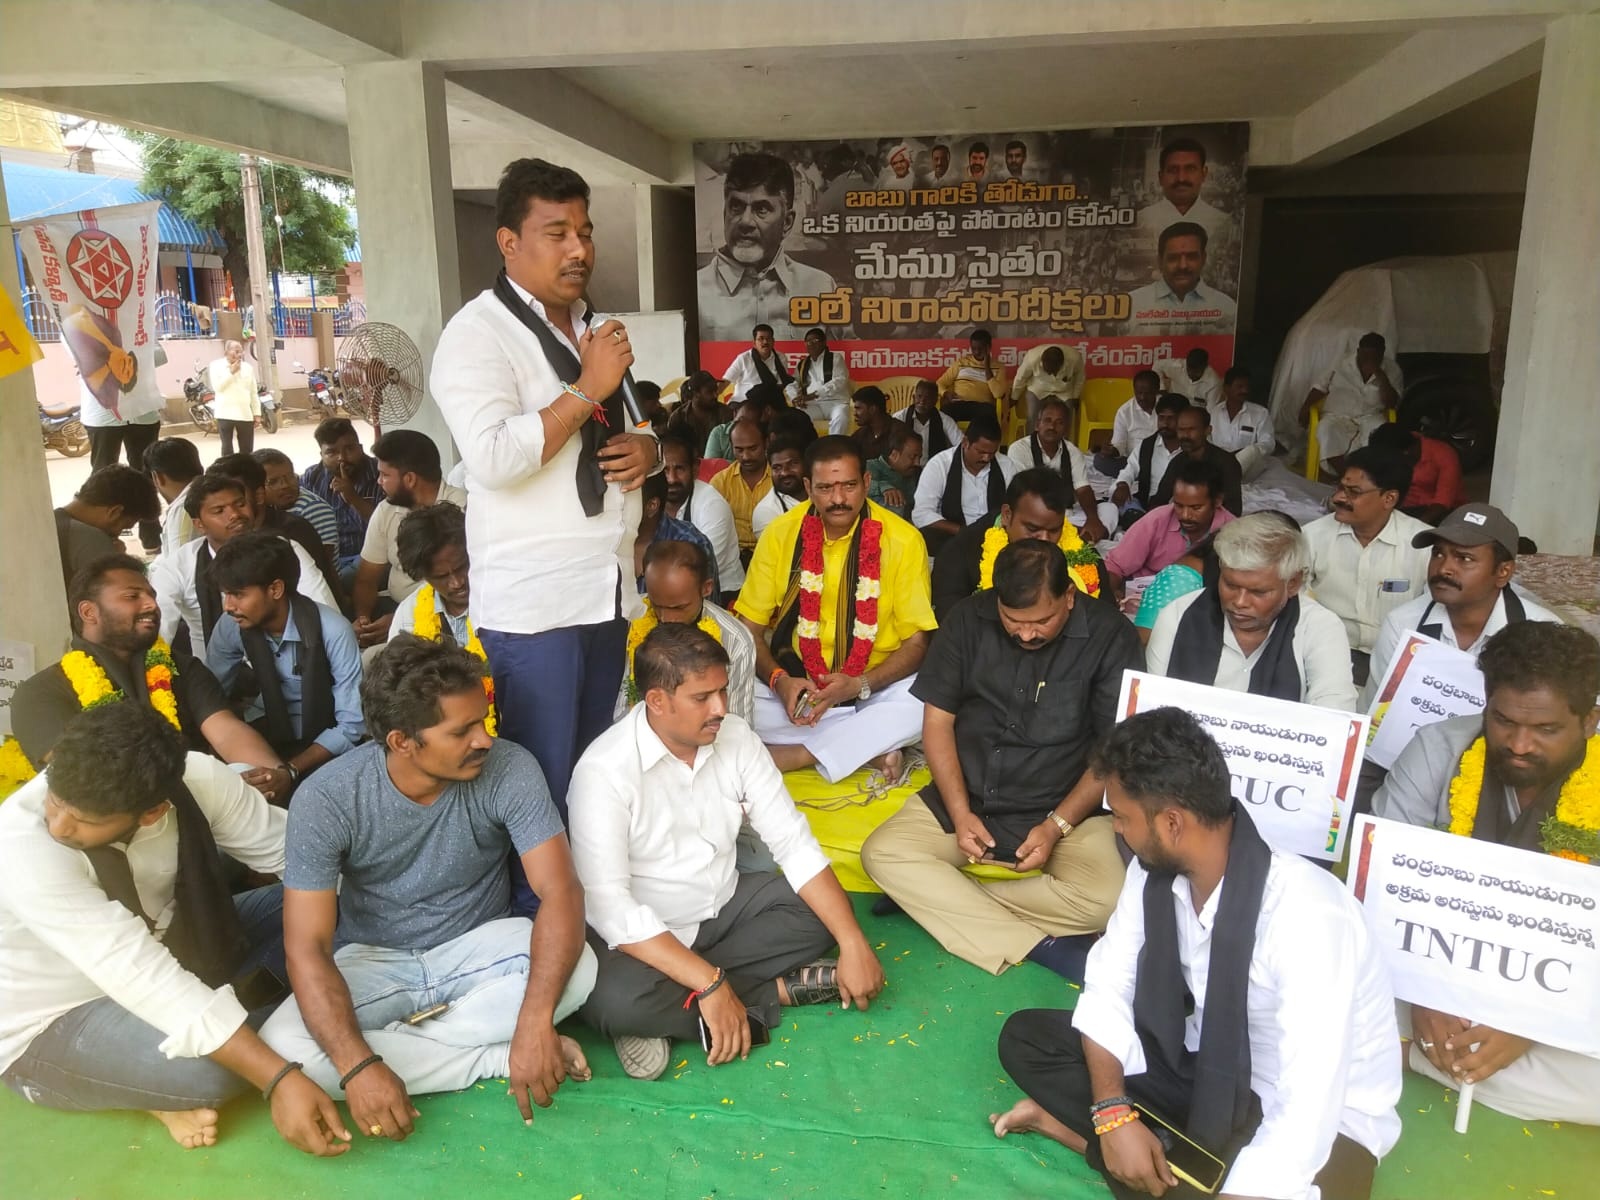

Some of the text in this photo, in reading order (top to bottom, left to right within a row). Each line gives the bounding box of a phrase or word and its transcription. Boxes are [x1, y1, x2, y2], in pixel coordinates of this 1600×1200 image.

[846, 190, 905, 207] బాబు
[910, 181, 978, 206] గారికి
[803, 202, 1135, 237] ఒక నియంతపై పోరాటం కోసం
[854, 242, 1062, 288] మేము సైతం
[790, 287, 853, 324] రిలే
[1411, 696, 1446, 716] అక్రమ
[1422, 675, 1485, 707] చంద్రబాబు
[1231, 719, 1328, 747] నాయుడుగారి
[1254, 750, 1325, 777] ఖండిస్తున్న
[1391, 853, 1597, 910] చంద్రబాబు నాయుడుగారి
[1385, 882, 1431, 903] అక్రమ
[1506, 912, 1597, 949] ఖండిస్తున్న
[1394, 918, 1573, 993] TNTUC
